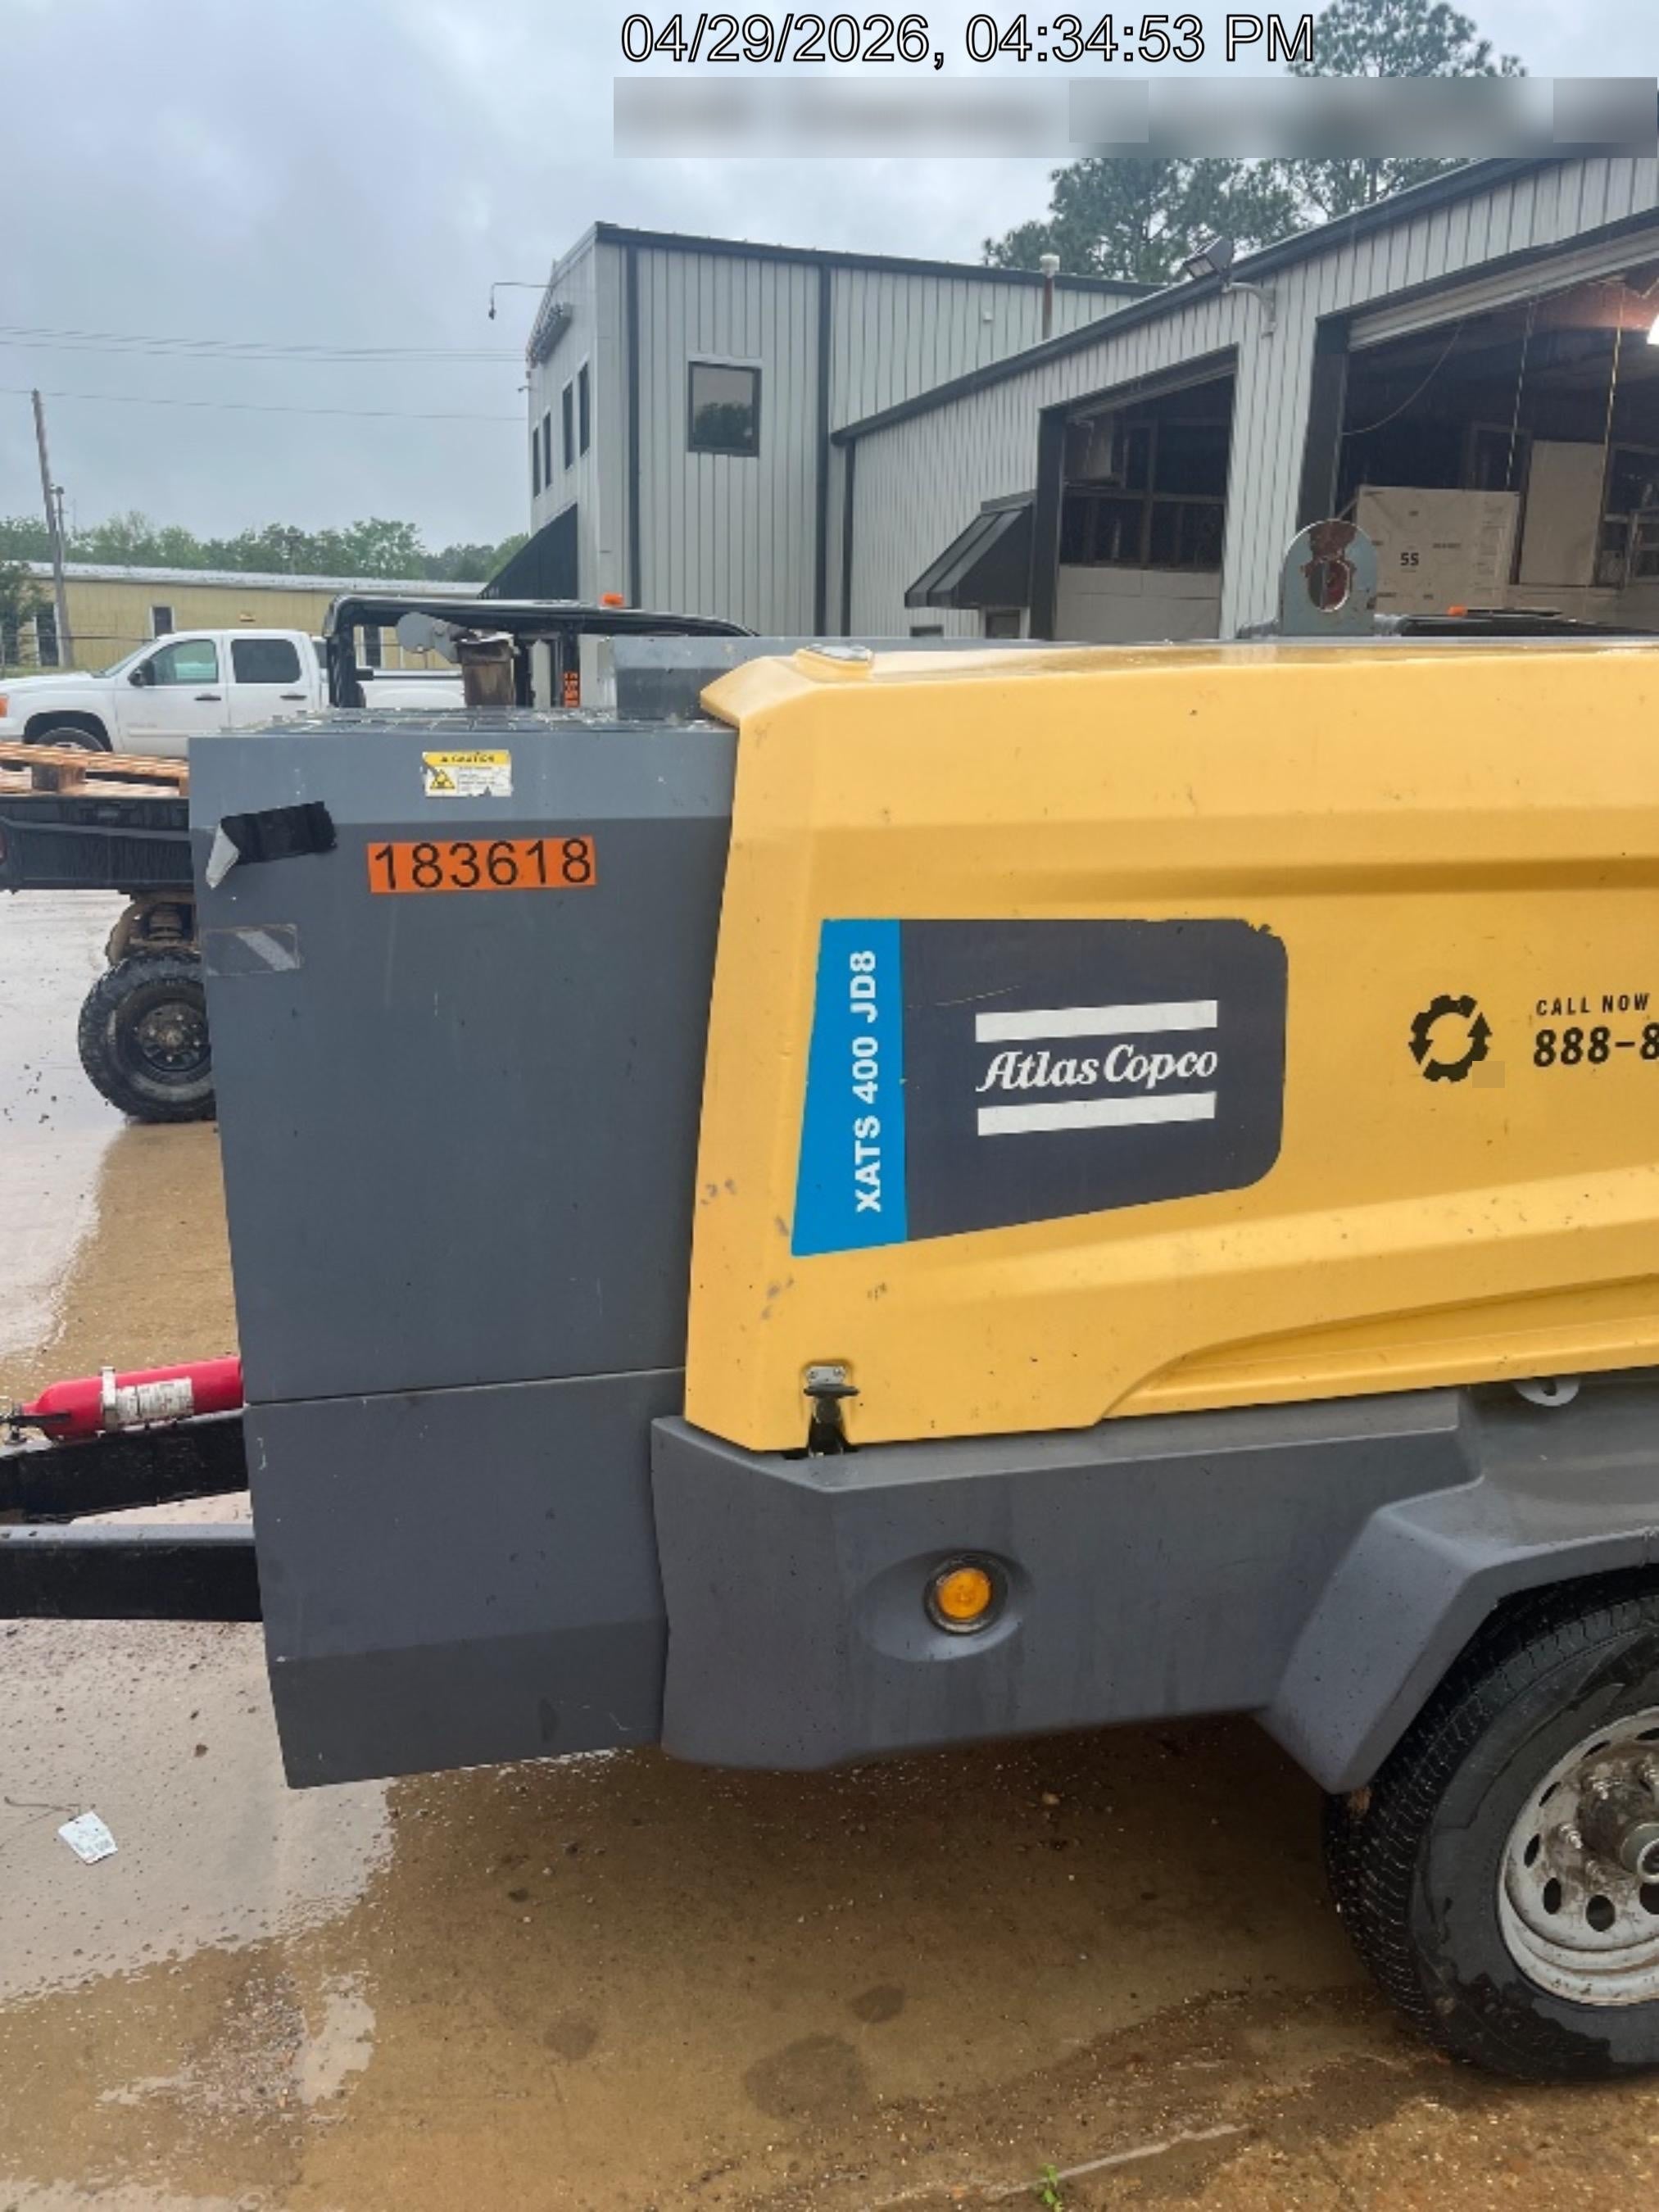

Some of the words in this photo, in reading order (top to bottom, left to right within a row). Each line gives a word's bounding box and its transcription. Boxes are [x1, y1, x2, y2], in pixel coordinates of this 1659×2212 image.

[375, 837, 592, 890] 183618
[850, 950, 877, 1023] JD8
[1535, 996, 1591, 1016] CALL
[1602, 992, 1650, 1013] NOW
[852, 1036, 878, 1104] 400
[975, 1050, 1099, 1092] Atlas
[1103, 1044, 1218, 1090] Copco
[1533, 1022, 1659, 1067] 888-8
[854, 1116, 881, 1213] XATS
